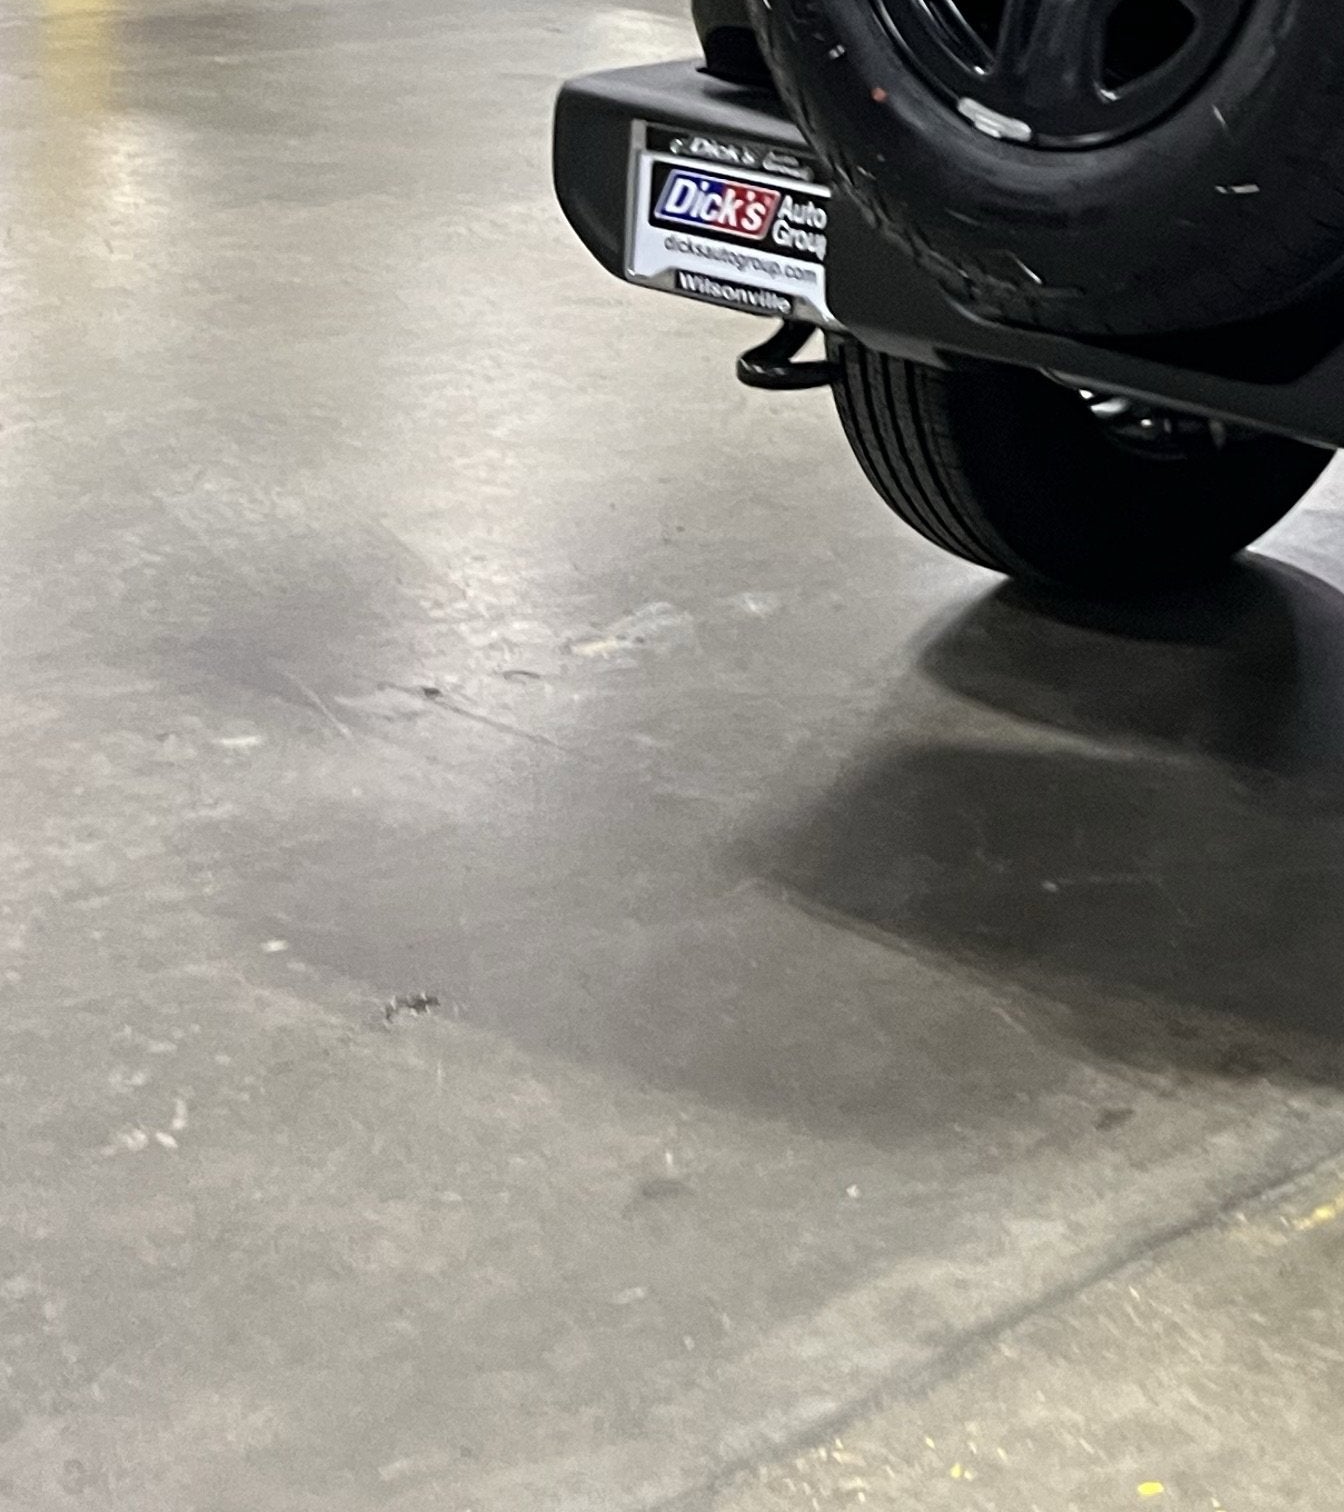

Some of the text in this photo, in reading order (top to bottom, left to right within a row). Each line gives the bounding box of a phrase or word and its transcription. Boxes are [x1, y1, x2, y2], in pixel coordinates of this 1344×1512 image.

[665, 177, 767, 231] Dick's
[776, 194, 827, 230] Auto
[664, 234, 817, 281] dicksautogroup.com
[678, 271, 791, 314] Wilsonville
